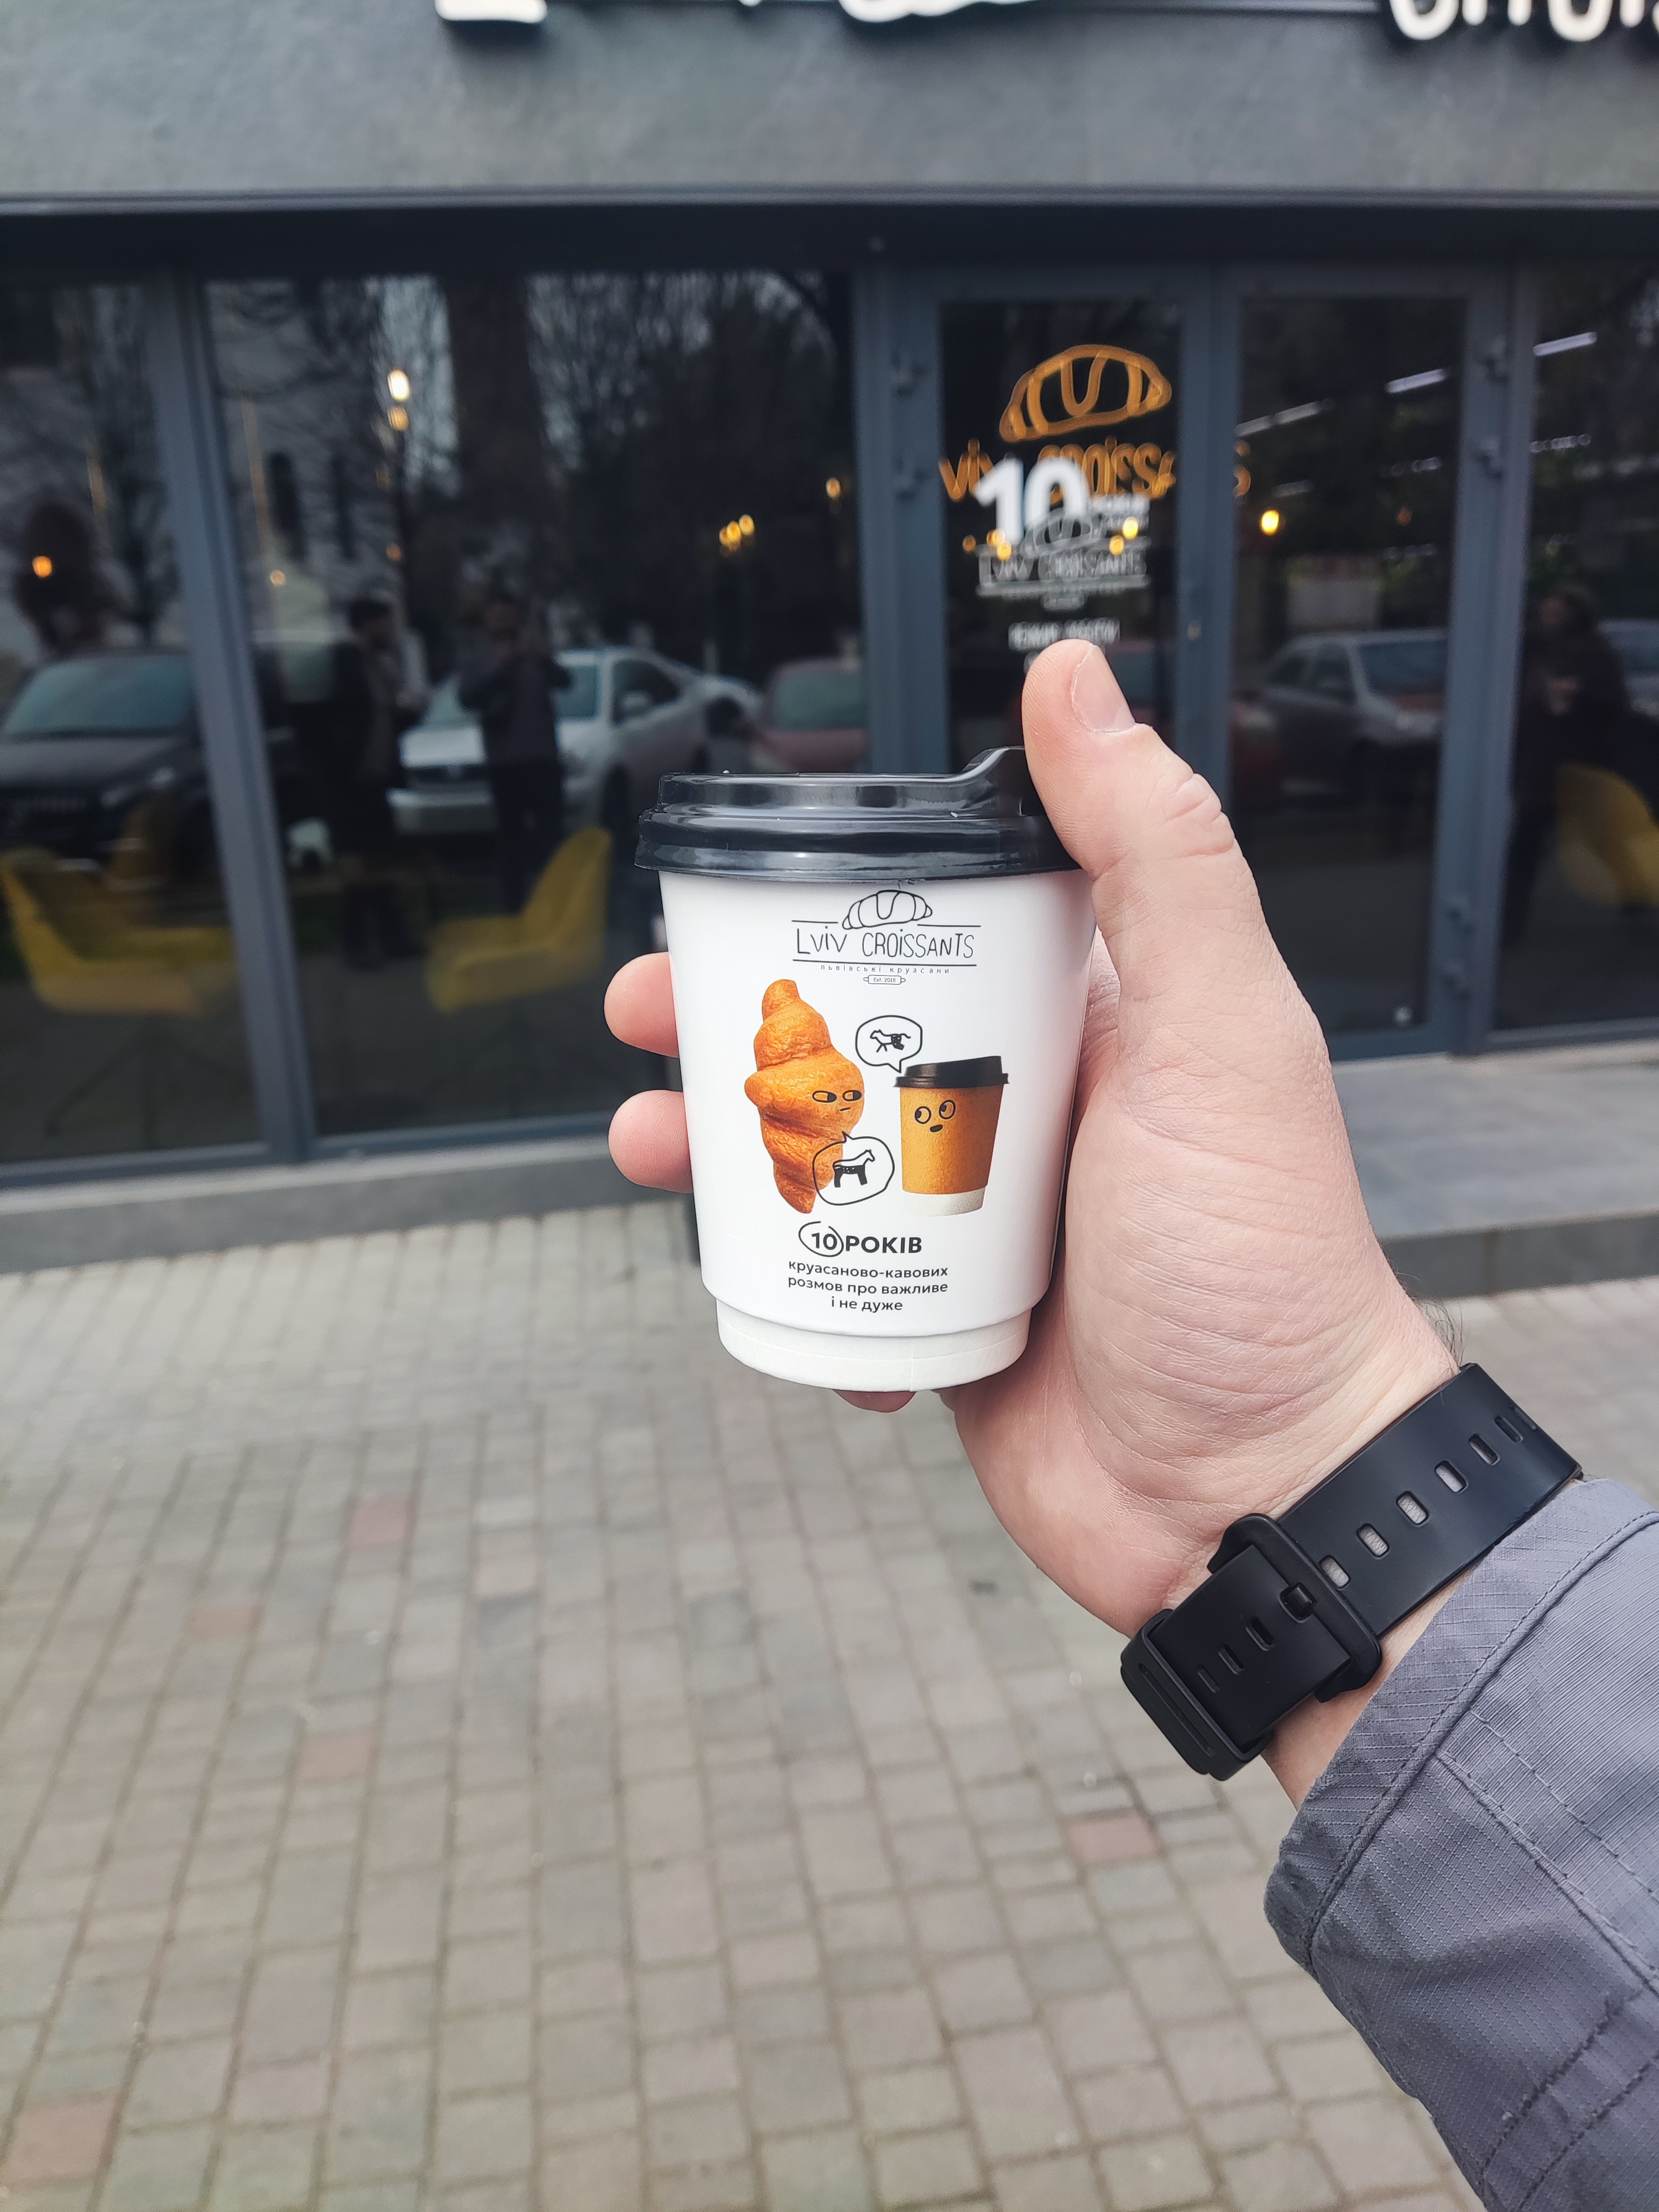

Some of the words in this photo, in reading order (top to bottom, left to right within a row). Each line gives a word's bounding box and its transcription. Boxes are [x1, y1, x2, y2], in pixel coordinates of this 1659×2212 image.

[973, 456, 1089, 544] 10
[811, 1232, 838, 1250] 10
[846, 1235, 922, 1254] РОКІВ
[789, 1261, 948, 1278] круасаново-кавових
[788, 1277, 843, 1292] розмов
[847, 1284, 877, 1296] про
[881, 1284, 948, 1295] важливе
[831, 1296, 834, 1307] і
[839, 1300, 858, 1310] не
[861, 1302, 903, 1313] дуже
